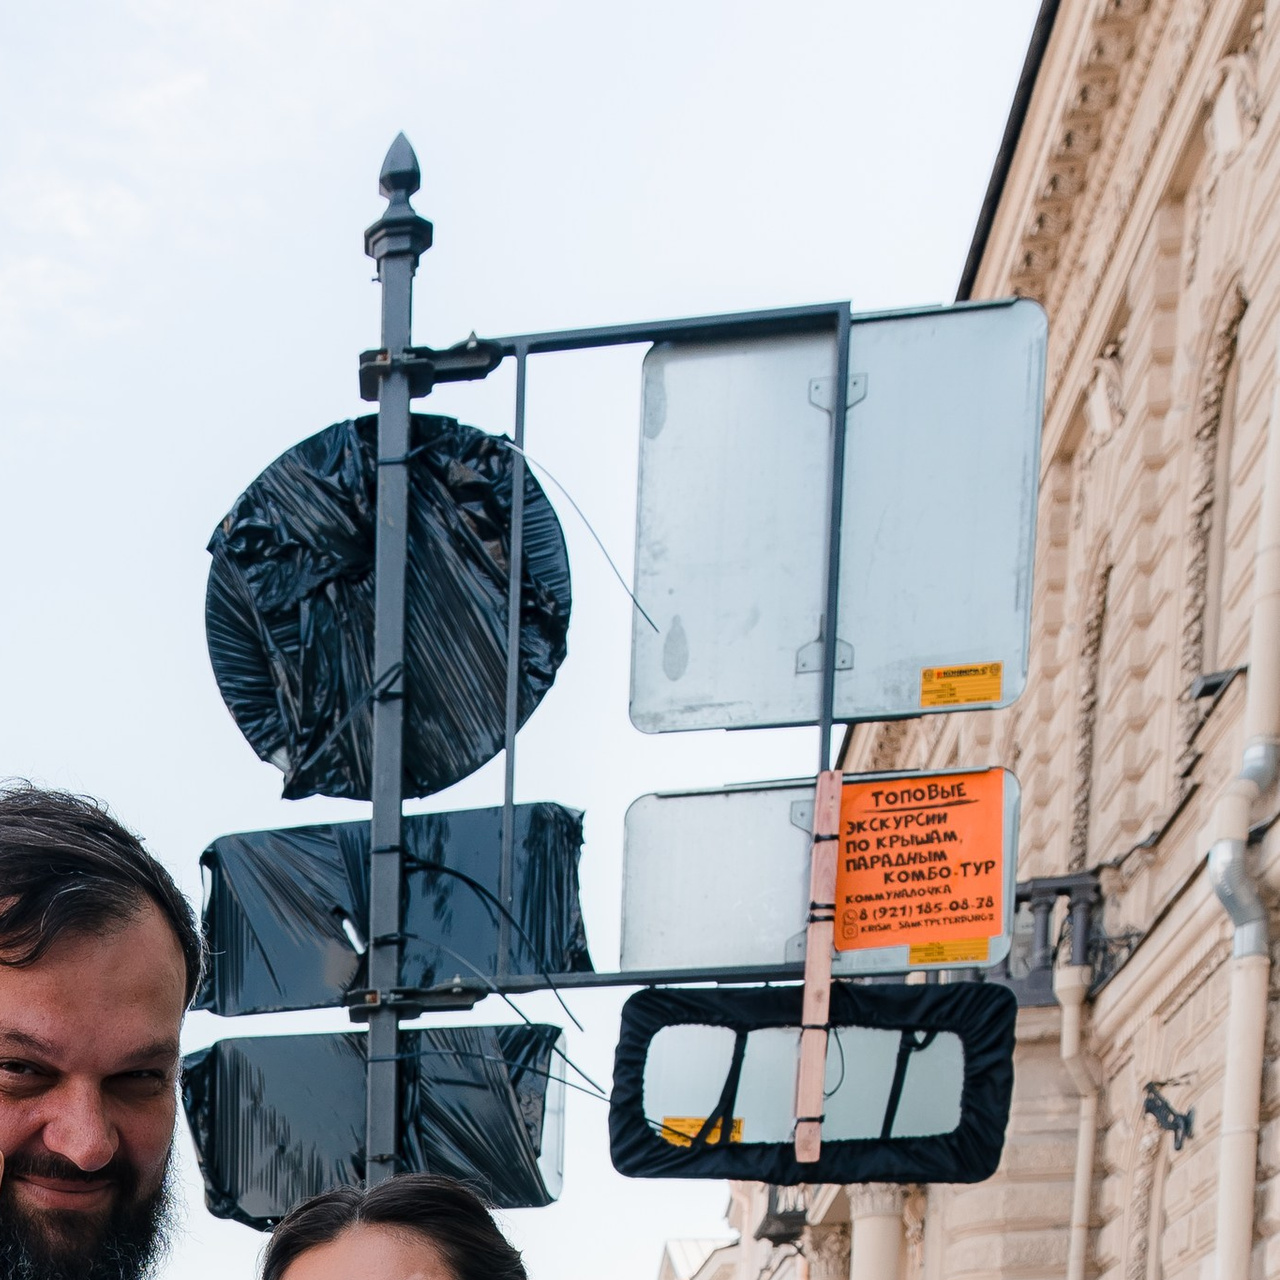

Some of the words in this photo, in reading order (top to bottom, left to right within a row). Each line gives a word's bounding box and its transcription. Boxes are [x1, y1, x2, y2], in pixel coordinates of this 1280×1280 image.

[871, 782, 967, 807] ТОПОВЫЕ
[846, 812, 948, 835] ЭКСКУРСИИ
[846, 839, 870, 854] ПО
[846, 850, 948, 872] ПАРАДНЫМ
[845, 884, 952, 904] КОММУНАЛОЧКА
[859, 908, 868, 921] 8
[873, 904, 913, 920] (921)
